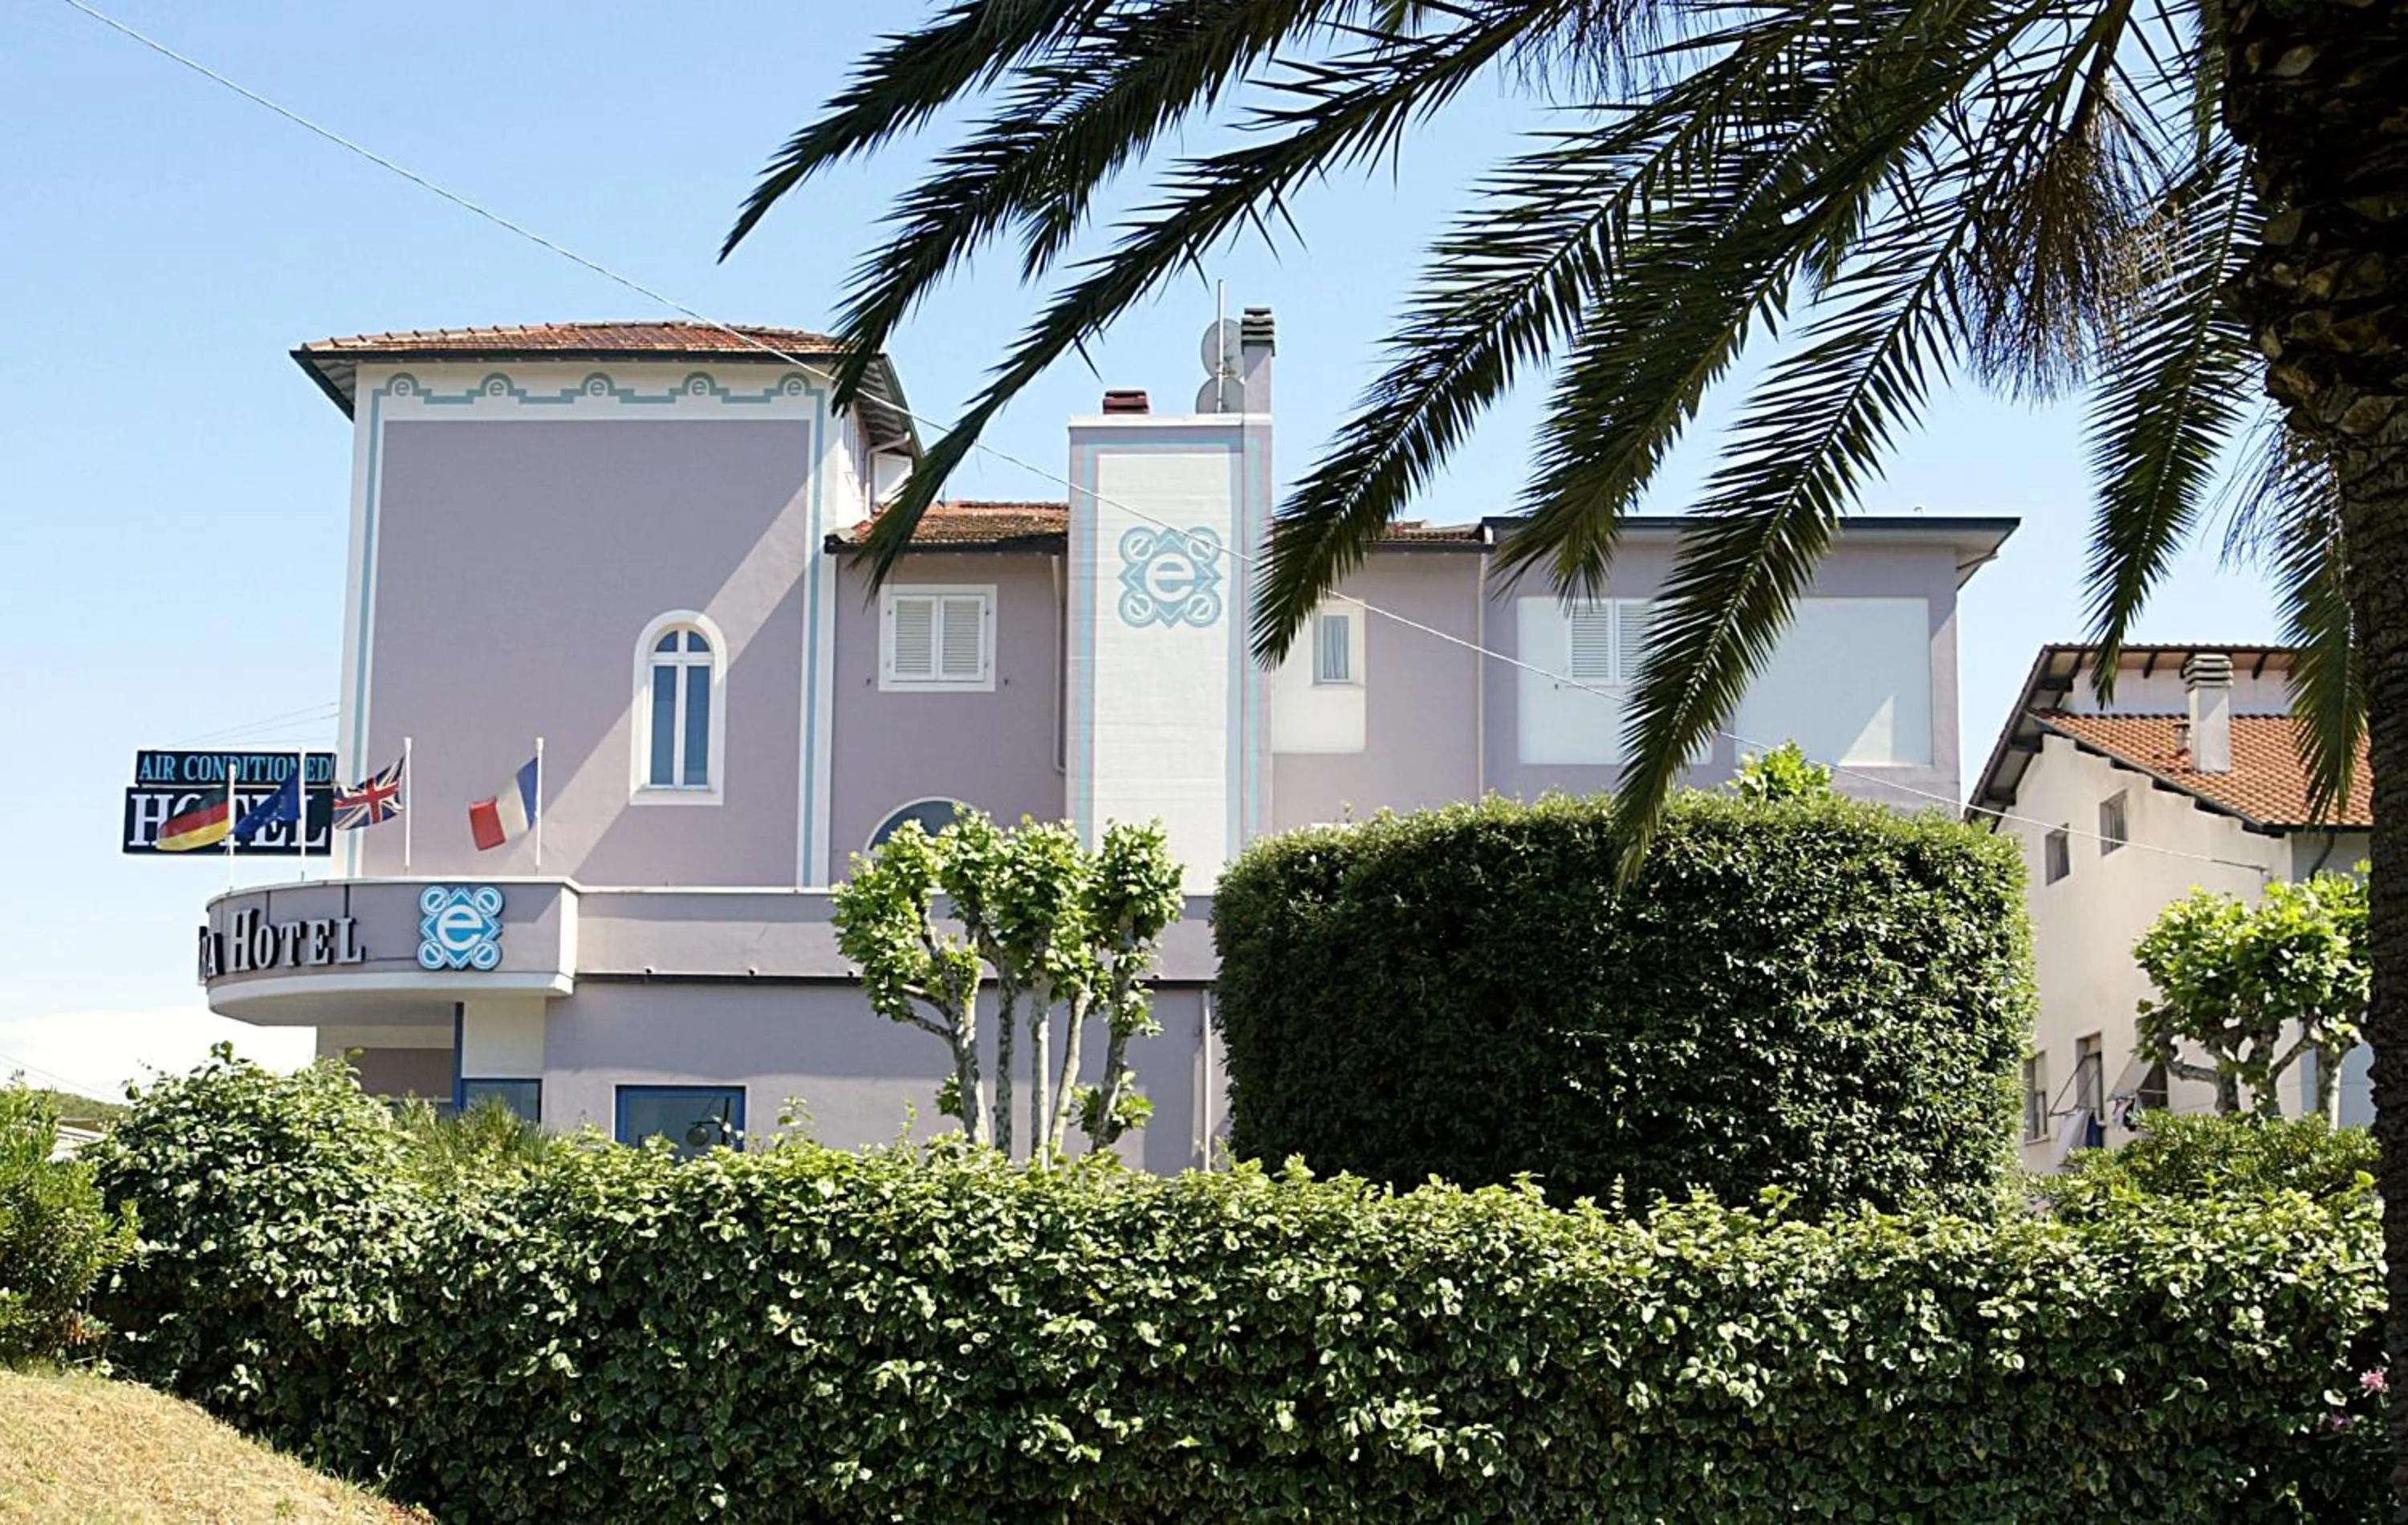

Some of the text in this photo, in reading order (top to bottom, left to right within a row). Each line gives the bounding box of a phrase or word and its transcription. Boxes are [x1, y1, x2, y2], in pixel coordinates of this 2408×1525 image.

[1145, 552, 1195, 602] e
[138, 754, 176, 780] AIR
[226, 908, 365, 971] HOTEL
[437, 904, 482, 950] e
